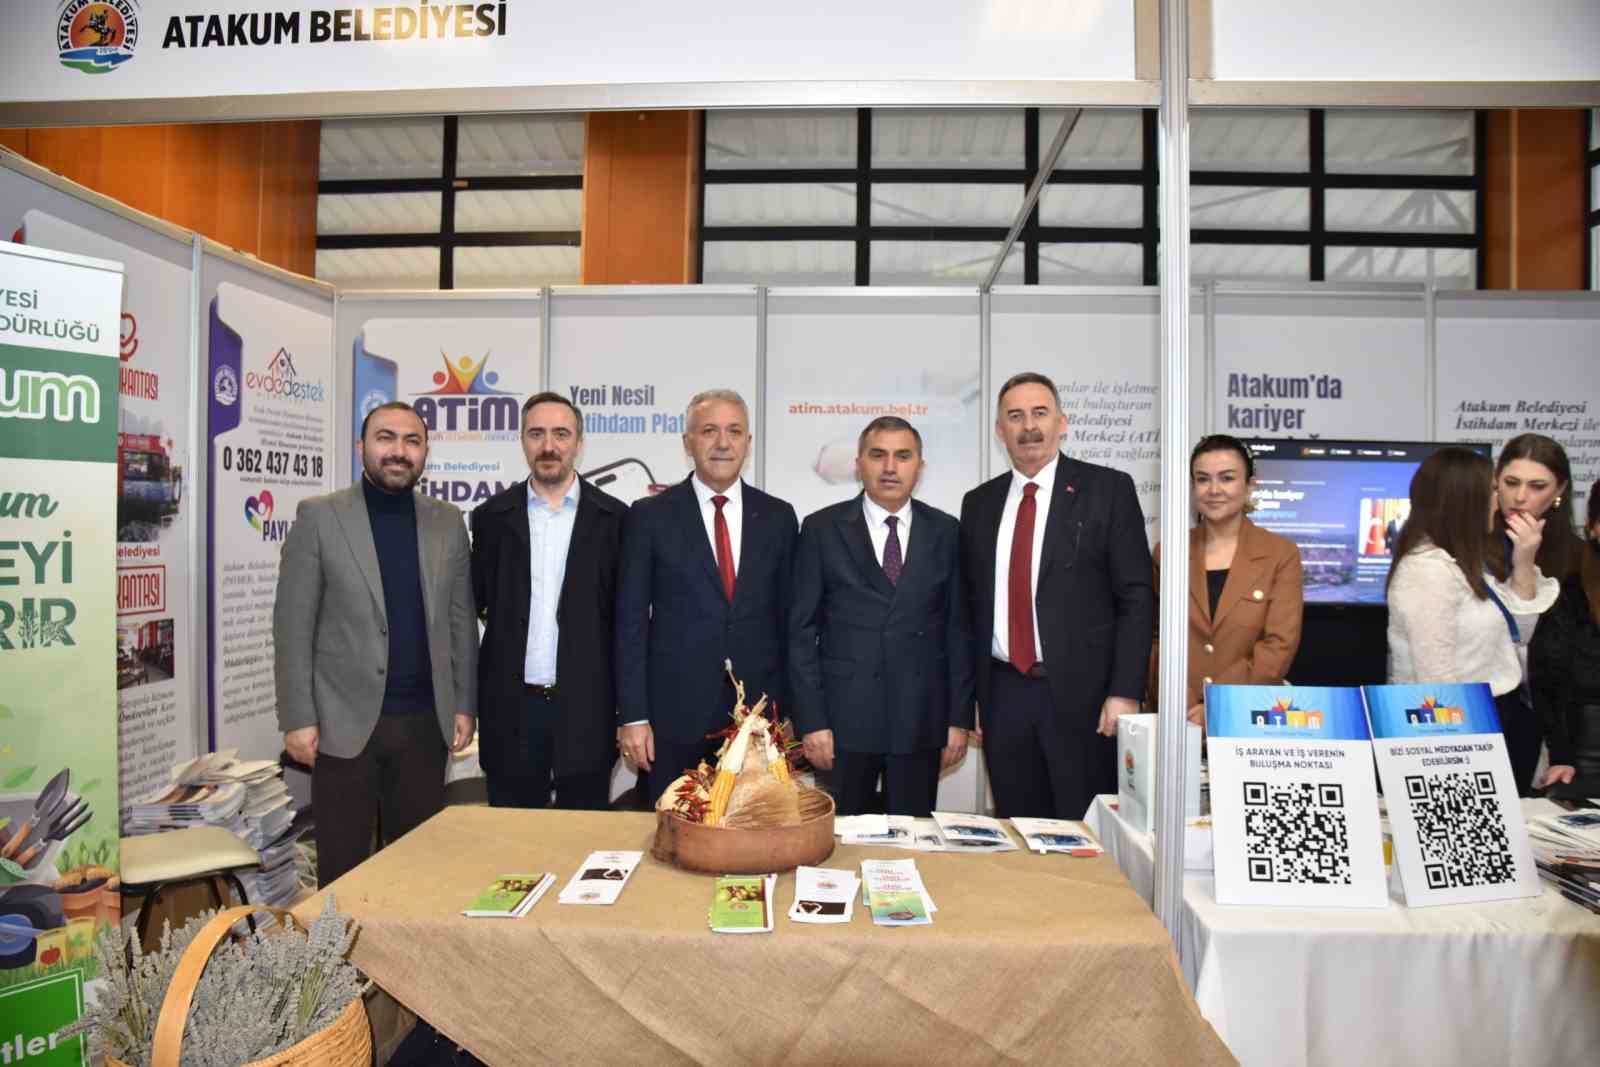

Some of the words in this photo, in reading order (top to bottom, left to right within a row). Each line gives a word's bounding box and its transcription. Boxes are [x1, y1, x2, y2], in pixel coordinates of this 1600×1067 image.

[163, 12, 299, 48] ATAKUM
[310, 0, 507, 42] BELEDİYESİ
[570, 385, 606, 405] Yeni
[612, 385, 655, 406] Nesil
[788, 401, 928, 416] atim.atakum.bel.tr
[1456, 400, 1511, 414] Atakum
[1515, 400, 1587, 417] Belediyesi
[584, 414, 645, 434] tihdam
[1227, 403, 1305, 432] kariyer
[1456, 415, 1518, 430] İstihdam
[1523, 418, 1578, 432] Merkezi
[1073, 430, 1125, 444] Merkezi
[223, 446, 232, 471] 0
[237, 448, 262, 474] 362
[266, 451, 289, 475] 437
[293, 454, 308, 477] 43
[312, 456, 323, 478] 18
[443, 460, 501, 473] Belediyesi
[1246, 748, 1281, 757] ARAYAN
[1283, 749, 1295, 757] VE
[1308, 748, 1345, 758] VERENİN
[1250, 759, 1292, 770] BULUŞMA
[1294, 761, 1333, 769] NOKTASI
